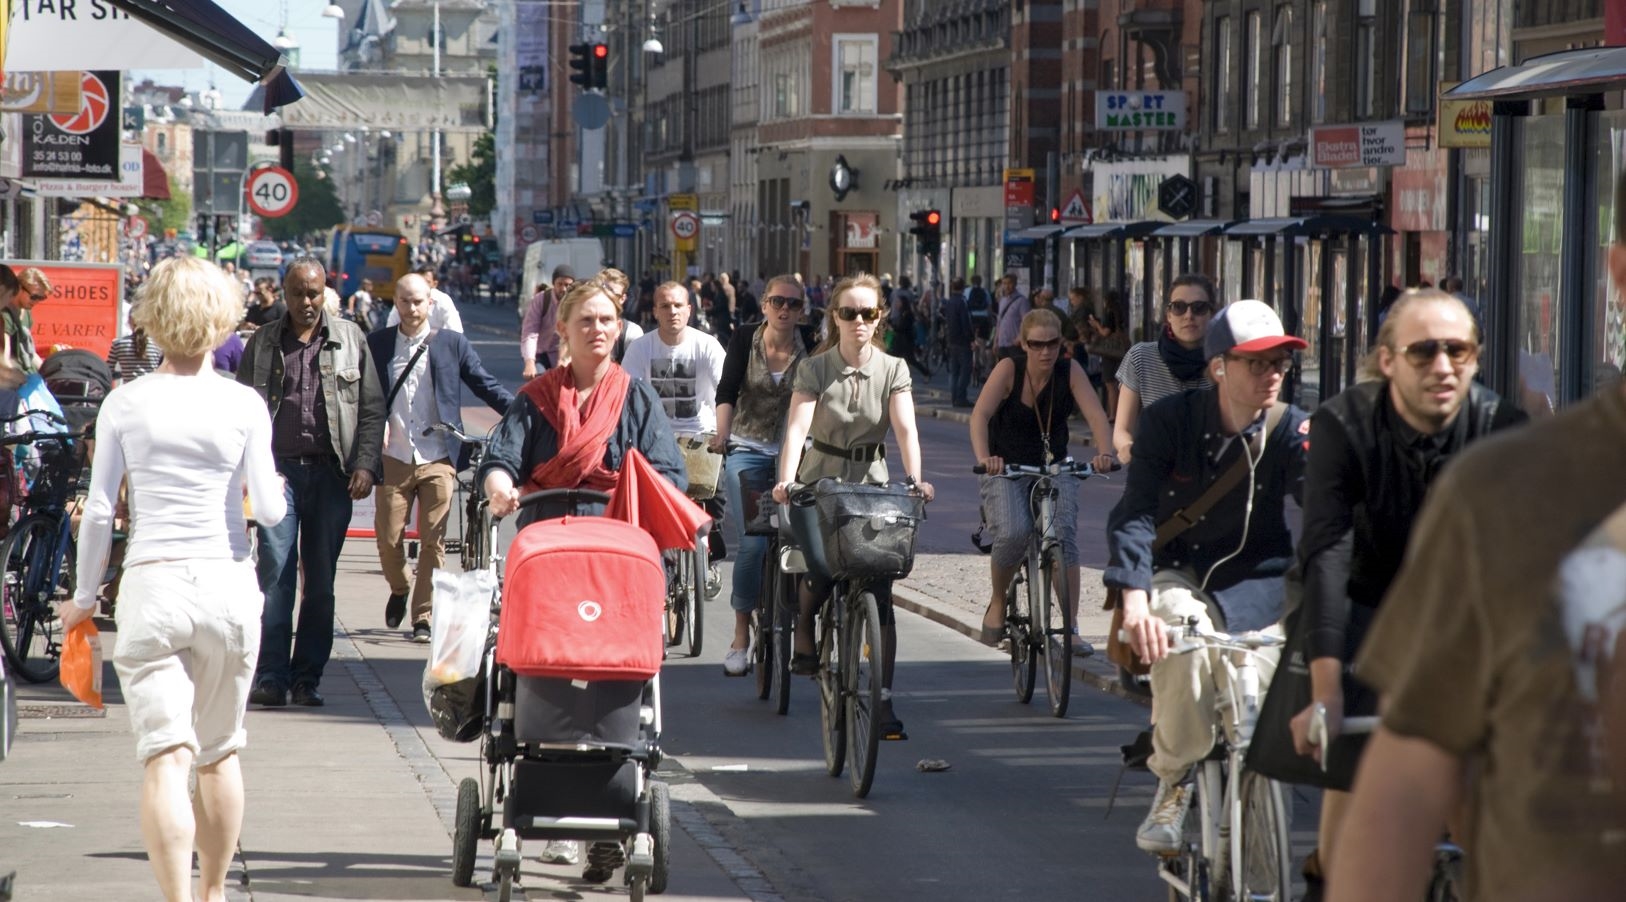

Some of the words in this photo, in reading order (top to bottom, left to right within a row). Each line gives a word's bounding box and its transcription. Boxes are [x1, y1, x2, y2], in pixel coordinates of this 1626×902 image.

[1106, 95, 1164, 110] SPORT
[1106, 112, 1176, 127] MASTER
[33, 134, 90, 145] KÆDEN
[1362, 137, 1386, 145] hvor
[1317, 141, 1358, 151] Ekstra
[1363, 145, 1395, 155] andre
[33, 151, 45, 161] 35
[58, 152, 70, 161] 53
[71, 152, 82, 162] 00
[1317, 150, 1358, 162] Bladet
[255, 183, 288, 201] 40
[677, 221, 694, 233] 40
[53, 285, 109, 300] SHOES
[51, 323, 106, 337] VARER
